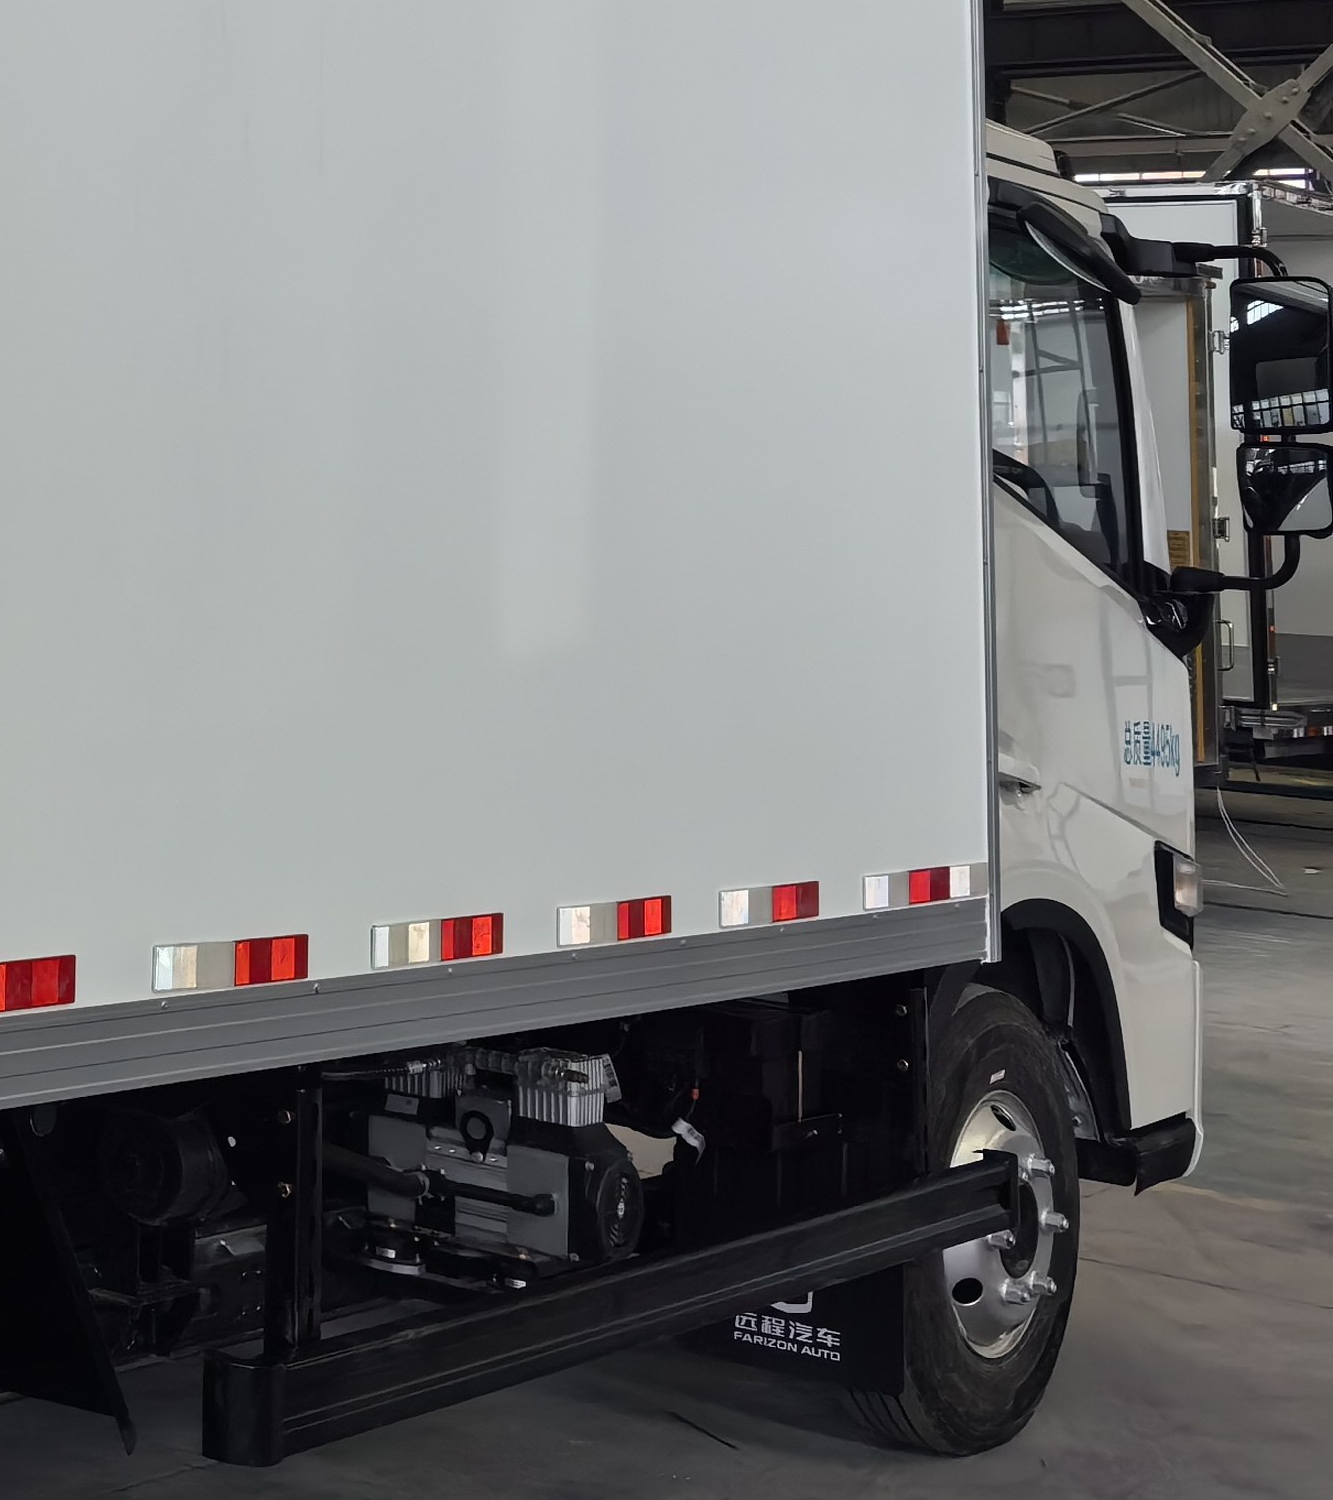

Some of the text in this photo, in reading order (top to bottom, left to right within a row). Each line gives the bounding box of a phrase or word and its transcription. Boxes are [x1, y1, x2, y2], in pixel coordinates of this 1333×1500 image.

[734, 1312, 841, 1347] 远程汽车
[734, 1331, 841, 1362] FARIZON AUTO
